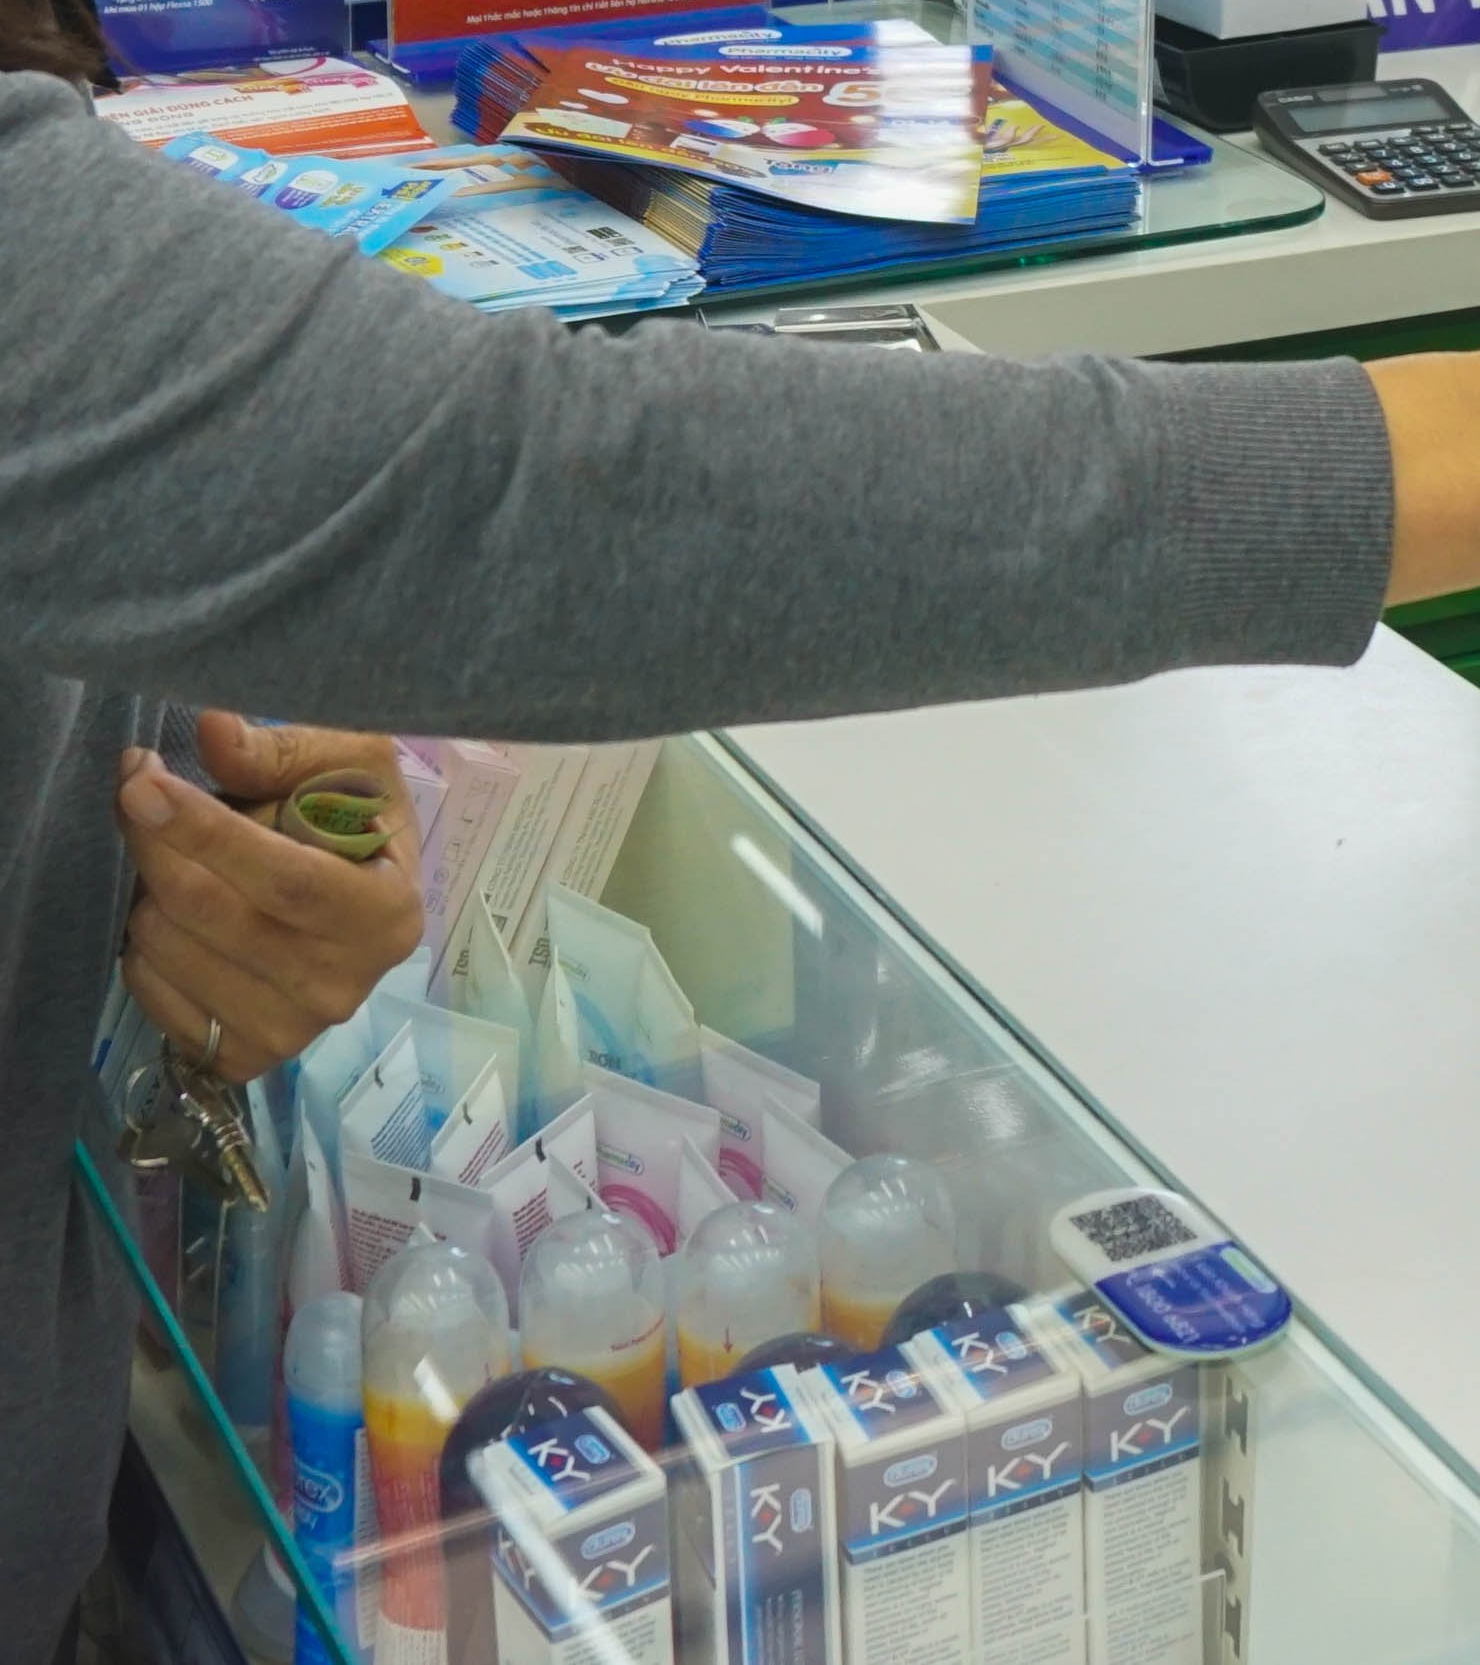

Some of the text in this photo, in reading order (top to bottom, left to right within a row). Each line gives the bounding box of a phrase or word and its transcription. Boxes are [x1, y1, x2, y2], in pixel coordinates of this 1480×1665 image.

[612, 58, 710, 77] Happy
[527, 1438, 591, 1482] KY
[1110, 1406, 1192, 1463] KY
[988, 1442, 1072, 1498] KY
[870, 1477, 957, 1536] KY
